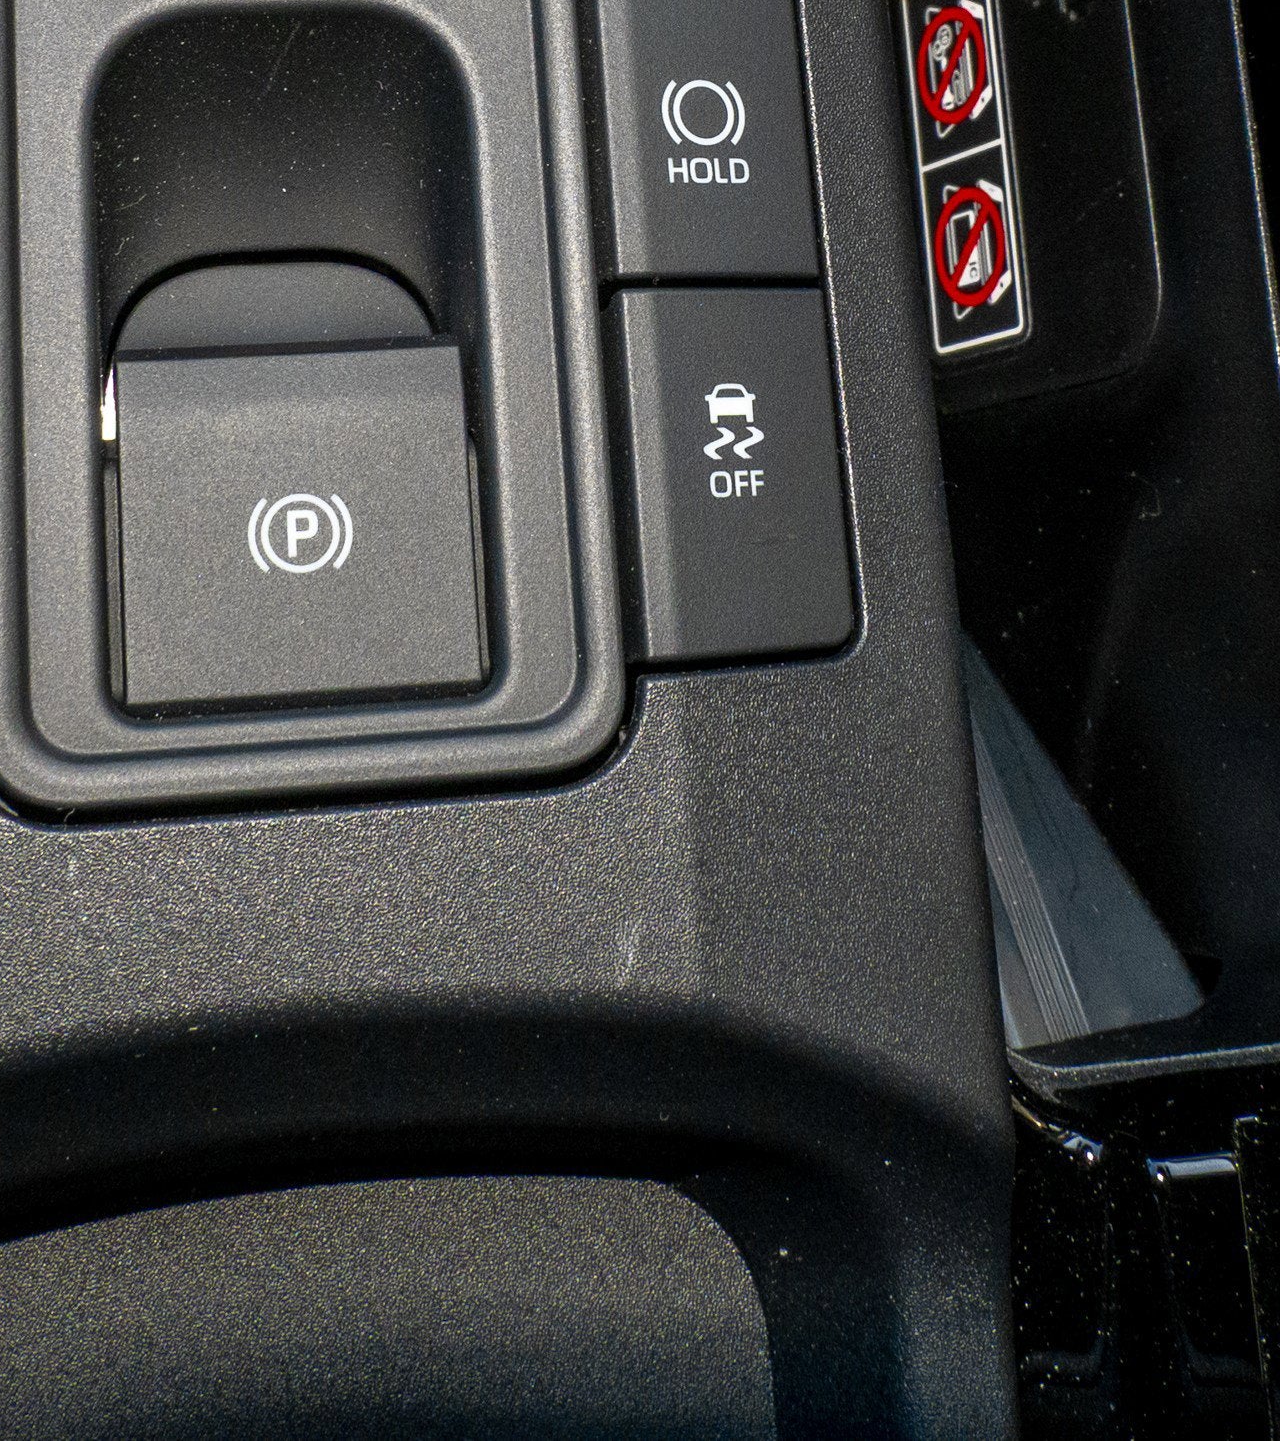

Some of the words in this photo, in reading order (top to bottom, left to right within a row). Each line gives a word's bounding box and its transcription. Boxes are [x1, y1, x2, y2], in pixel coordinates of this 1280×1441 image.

[667, 157, 750, 184] HOLD
[709, 469, 765, 498] OFF
[286, 509, 319, 558] P
